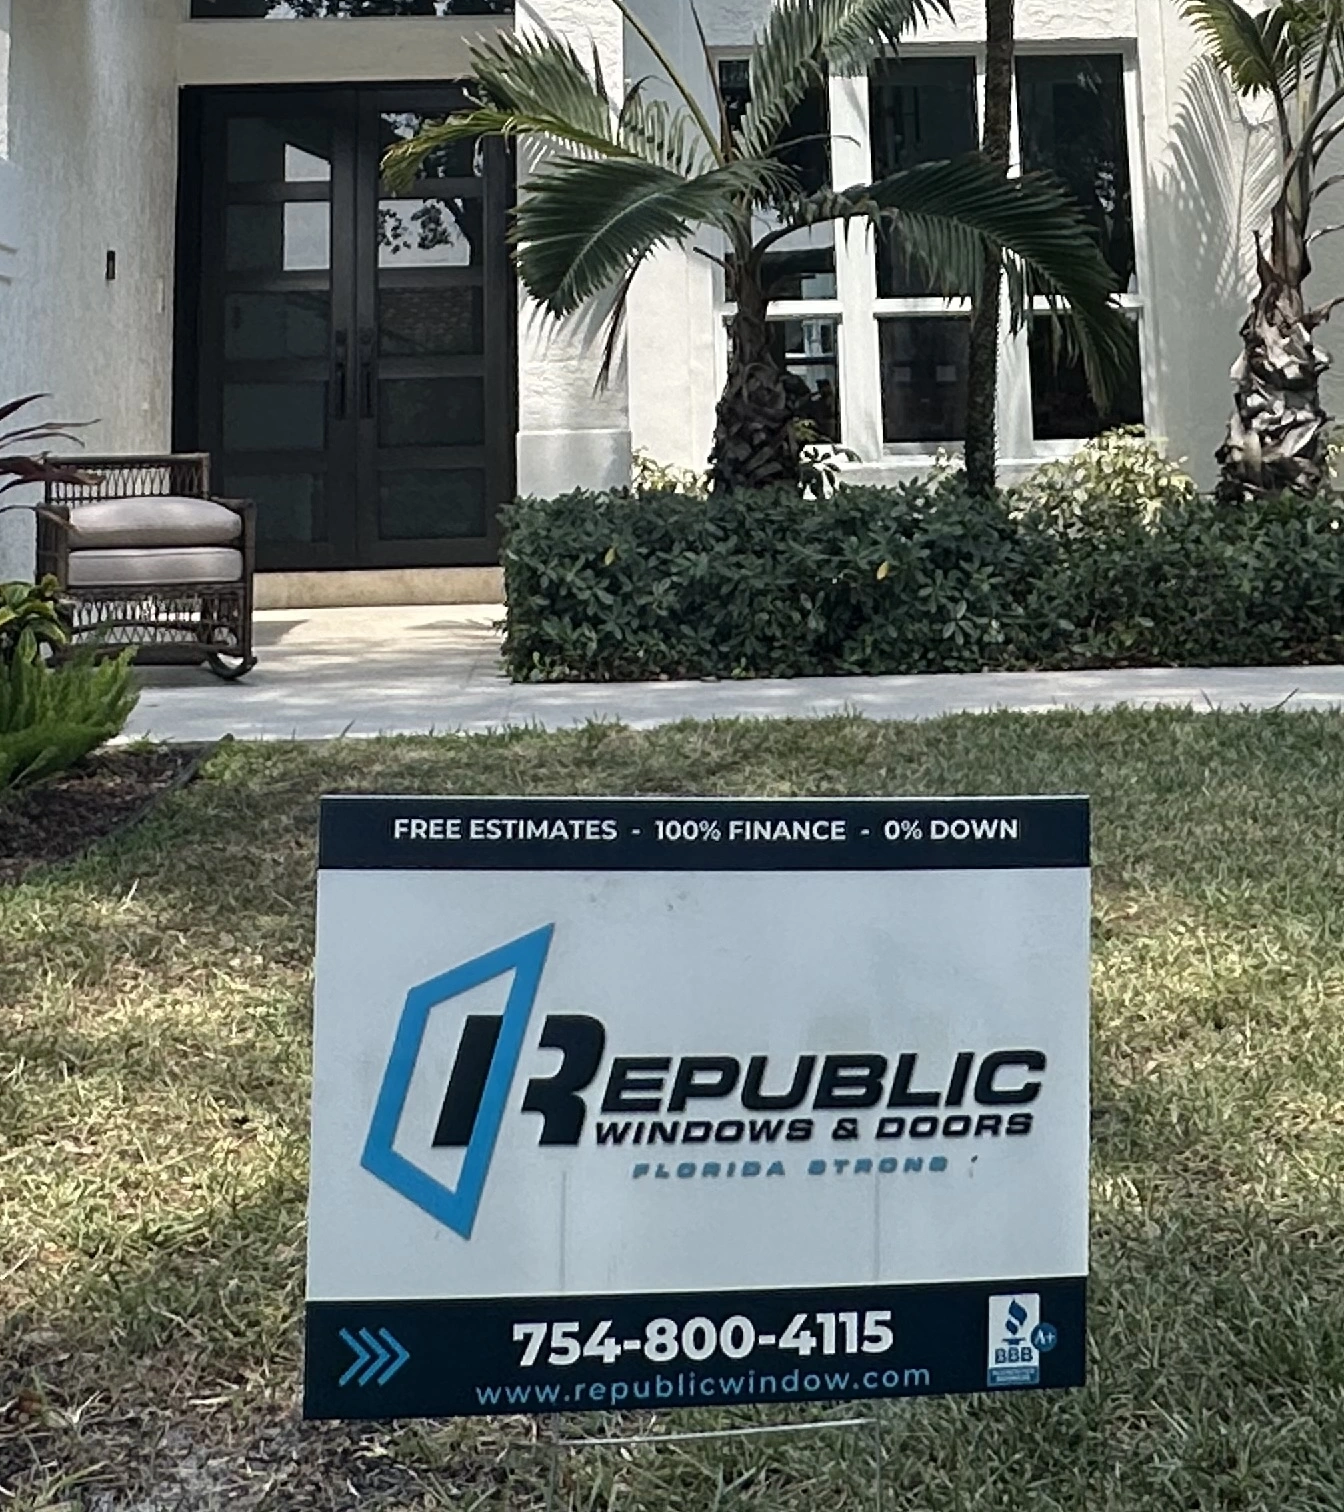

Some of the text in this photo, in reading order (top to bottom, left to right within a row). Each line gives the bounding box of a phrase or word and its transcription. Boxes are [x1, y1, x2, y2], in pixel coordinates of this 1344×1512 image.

[393, 819, 462, 840] FREE
[469, 819, 618, 840] ESTIMATES
[655, 820, 722, 841] 100%
[728, 820, 847, 841] FINANCE
[883, 820, 923, 841] 0%
[930, 819, 1019, 841] DOWN
[430, 1012, 1046, 1149] REPUBLIC
[595, 1112, 1034, 1145] WINDOWS & DOORS
[632, 1161, 786, 1179] FLORIDA
[512, 1309, 895, 1368] 754-800-4115
[1034, 1329, 1056, 1345] A+
[994, 1347, 1033, 1365] BBB
[475, 1368, 932, 1407] www.republicwindow.com
